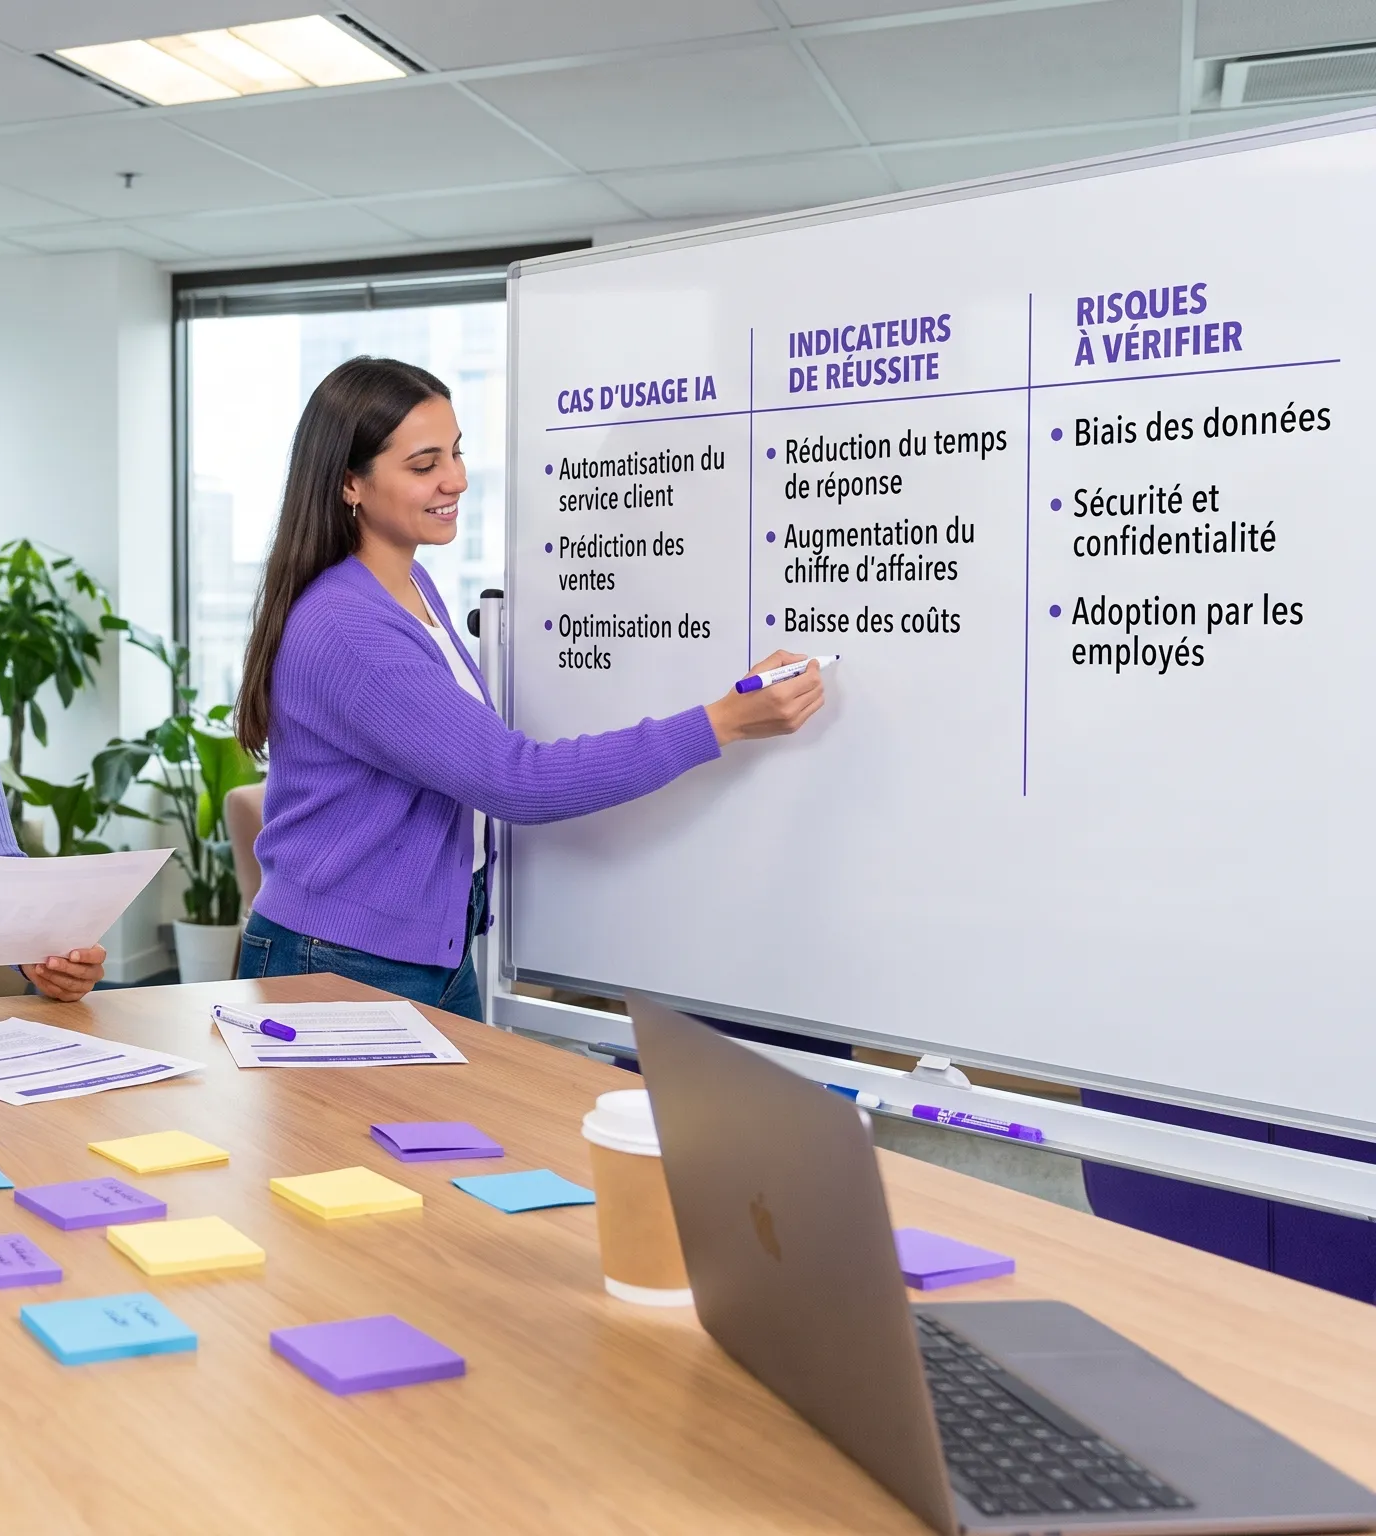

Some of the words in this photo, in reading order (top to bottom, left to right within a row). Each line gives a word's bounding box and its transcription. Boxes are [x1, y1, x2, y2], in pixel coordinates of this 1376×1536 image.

[1076, 283, 1207, 327] RISQUES
[789, 314, 951, 358] INDICATEURS
[1074, 329, 1095, 366] À
[1102, 321, 1242, 363] VÉRIFIER
[789, 366, 817, 393] DE
[825, 352, 938, 389] RÉUSSITE
[557, 388, 593, 414] CAS
[600, 378, 687, 410] D'USAGE
[694, 376, 716, 401] IA
[1075, 415, 1137, 446] Biais
[1145, 411, 1193, 442] des
[1203, 401, 1330, 438] données
[558, 449, 694, 480] Automatisation
[700, 445, 724, 470] du
[785, 434, 890, 464] Réduction
[898, 429, 926, 457] du
[933, 430, 1007, 460] temps
[558, 487, 618, 512] service
[623, 482, 674, 509] client
[784, 473, 809, 499] de
[816, 471, 902, 505] réponse
[1073, 483, 1182, 517] Sécurité
[1192, 485, 1219, 513] et
[559, 534, 646, 558] Prédiction
[652, 531, 684, 556] des
[783, 518, 938, 555] Augmentation
[945, 515, 974, 544] du
[1073, 521, 1276, 557] confidentialité
[558, 570, 615, 590] ventes
[784, 555, 849, 583] chiffre
[855, 553, 957, 582] d'affaires
[558, 614, 672, 644] Optimisation
[677, 613, 710, 638] des
[784, 607, 849, 632] Baisse
[855, 606, 893, 633] des
[900, 606, 960, 633] coûts
[1071, 595, 1195, 634] Adoption
[1207, 603, 1253, 634] par
[1263, 593, 1303, 625] les
[558, 645, 611, 669] stocks
[1071, 635, 1204, 675] employés
